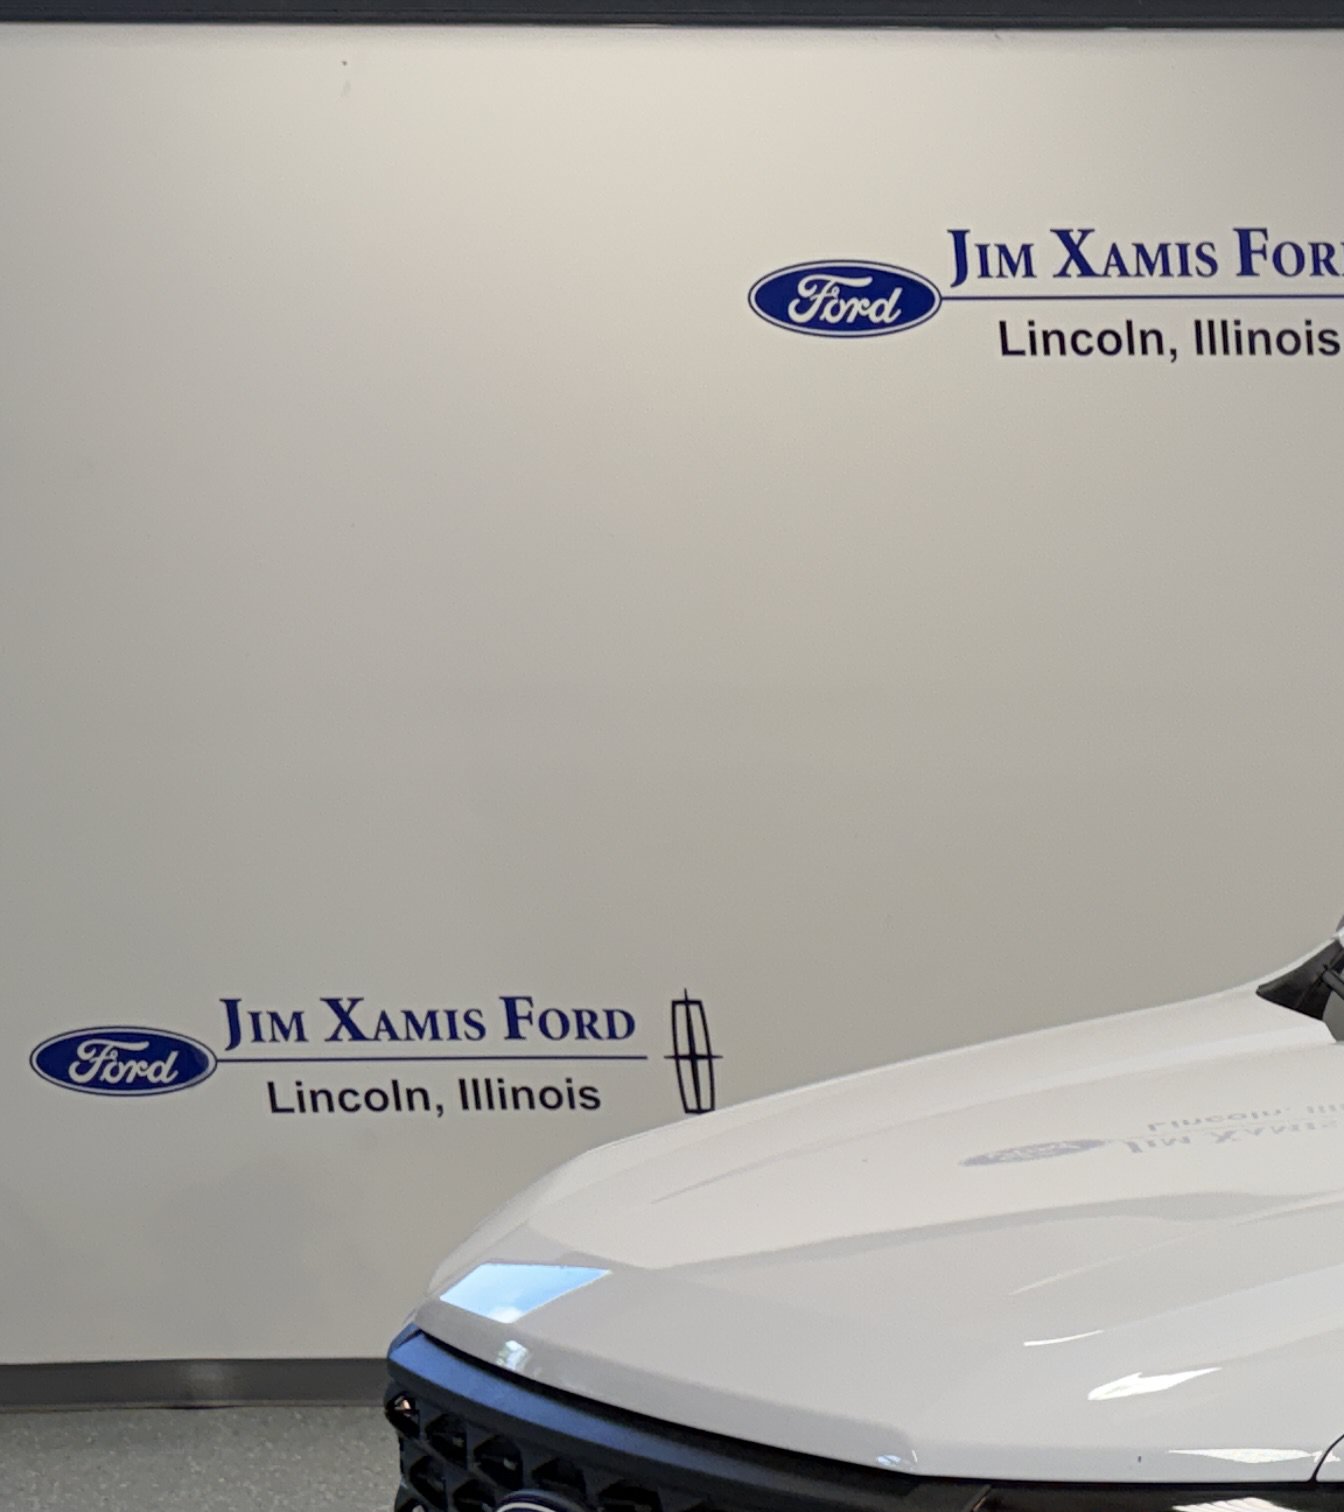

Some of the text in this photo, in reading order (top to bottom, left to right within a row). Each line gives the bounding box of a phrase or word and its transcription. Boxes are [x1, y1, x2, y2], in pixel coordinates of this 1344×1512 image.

[947, 229, 1034, 288] JIM
[1049, 228, 1219, 278] XAMIS
[787, 274, 903, 325] Ford
[999, 319, 1341, 363] Lincoln, Illinois
[219, 996, 636, 1051] JIM XAMIS FORD
[68, 1038, 179, 1084] Ford
[267, 1078, 601, 1117] Lincoln, Illinois
